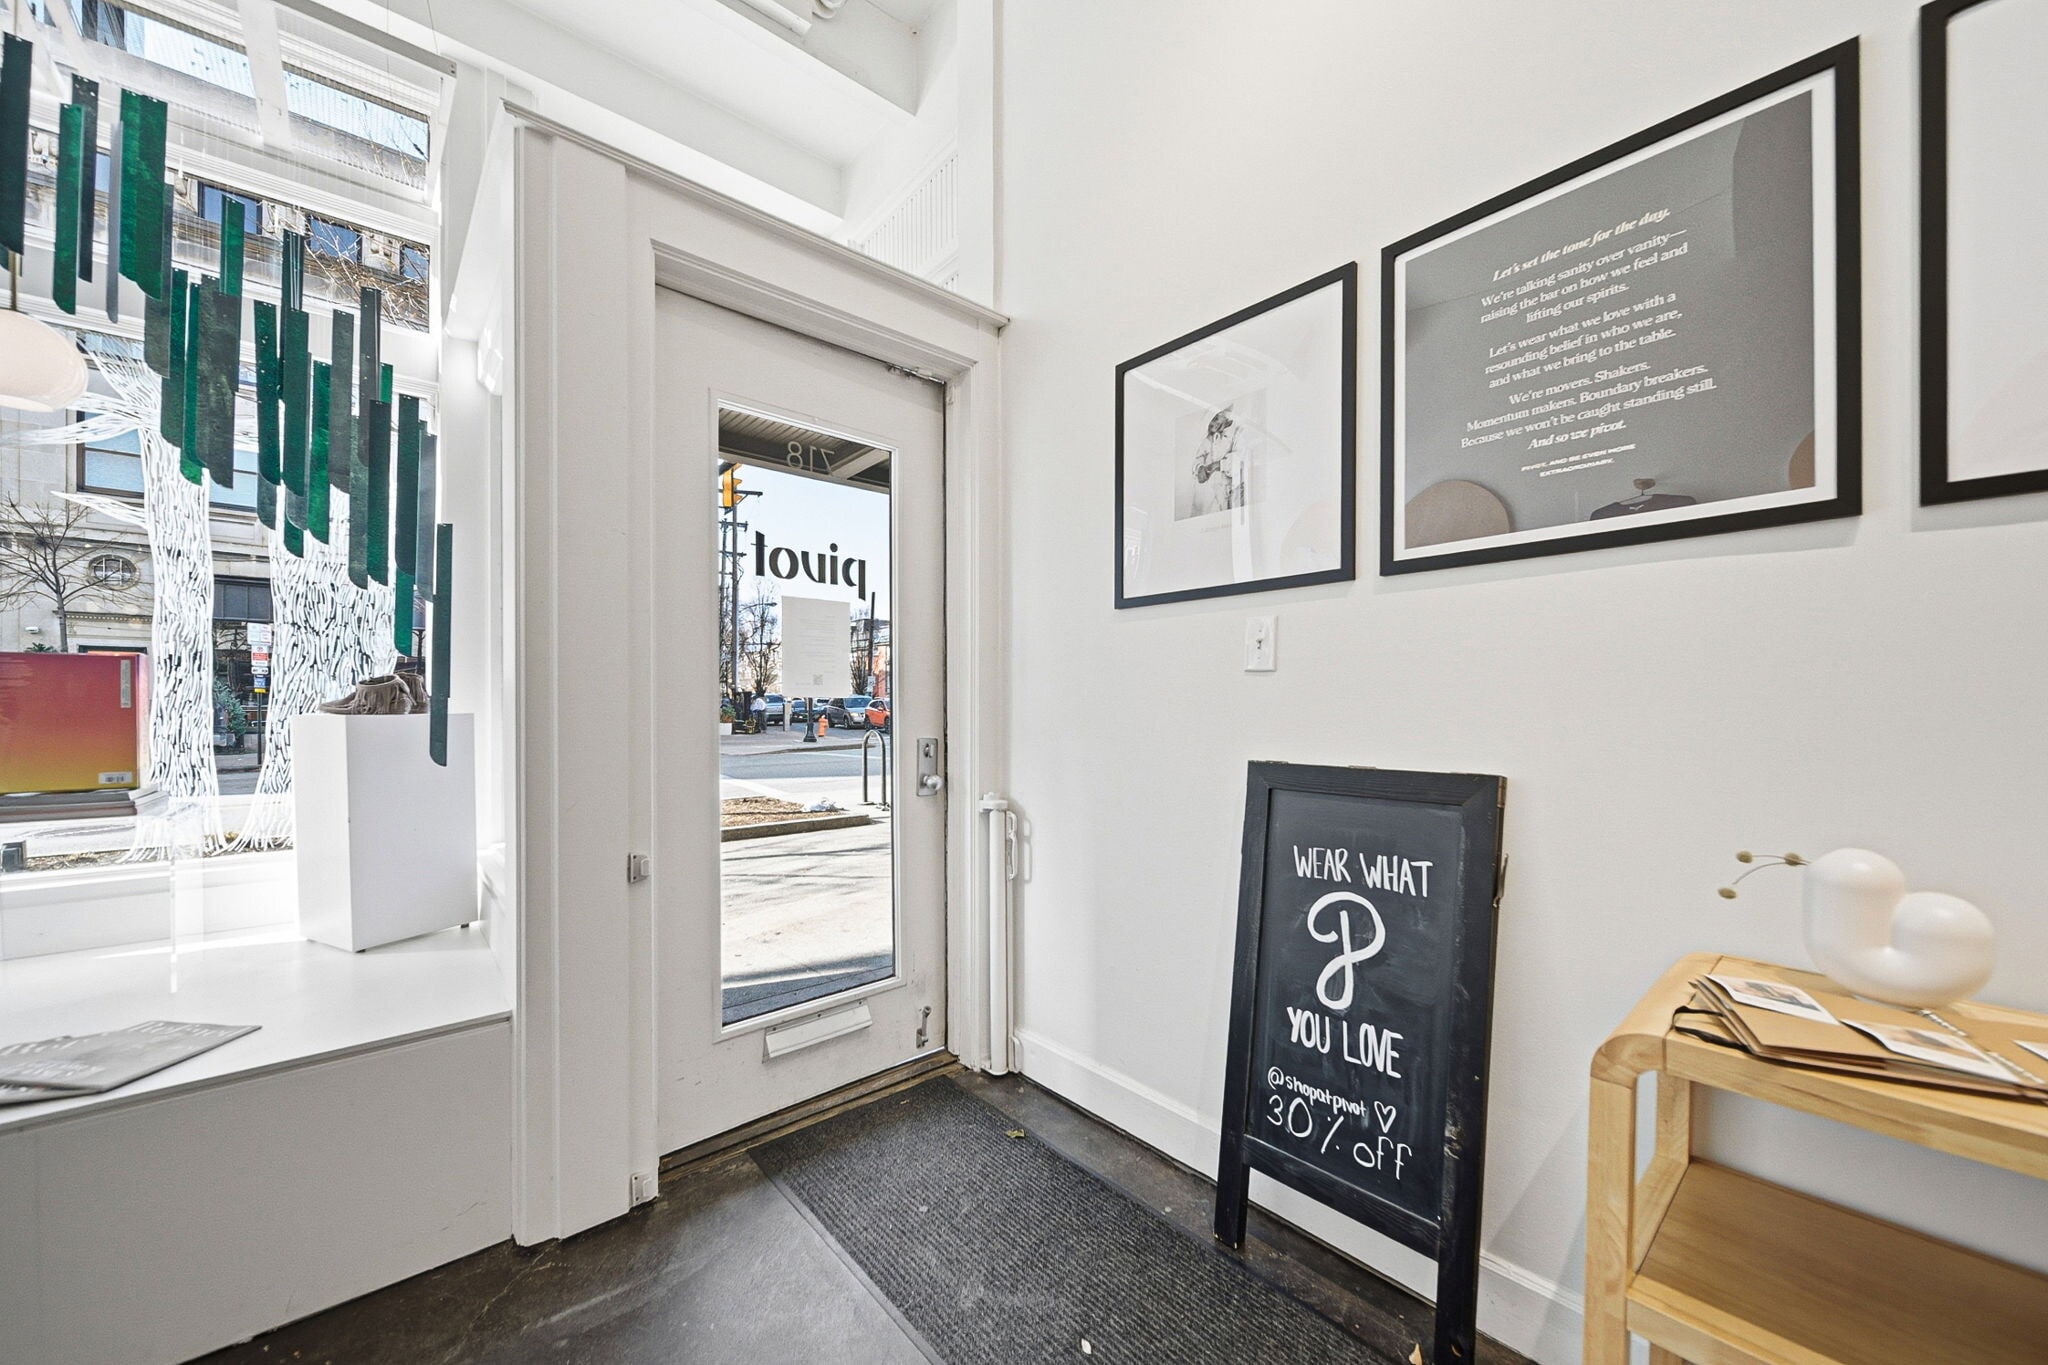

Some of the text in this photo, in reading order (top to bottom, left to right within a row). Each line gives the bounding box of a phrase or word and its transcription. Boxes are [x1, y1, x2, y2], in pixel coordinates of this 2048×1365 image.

[1493, 208, 1671, 281] Let's set the tone for the day.
[1480, 241, 1688, 324] raising the bar on how we feel and
[1481, 290, 1515, 307] We're
[1515, 273, 1556, 296] talking
[1557, 260, 1595, 281] sanity
[1595, 249, 1626, 267] over
[1526, 283, 1630, 323] lifting our spirits.
[1484, 309, 1683, 375] resounding belief in who we are,
[1489, 293, 1677, 359] Let's wear what we love with a
[1489, 328, 1677, 389] and what we bring to the table.
[1509, 361, 1651, 405] We're movers. Shakers.
[1461, 378, 1717, 448] Because we won't be caught standing still.
[1466, 365, 1709, 432] Momentum makers. Boundary breakers.
[1527, 420, 1627, 450] And so we pivot.
[1293, 845, 1433, 898] WEAR WHAT
[1286, 1006, 1404, 1078] YOU LOVE
[1267, 1066, 1367, 1117] @shopatpivot
